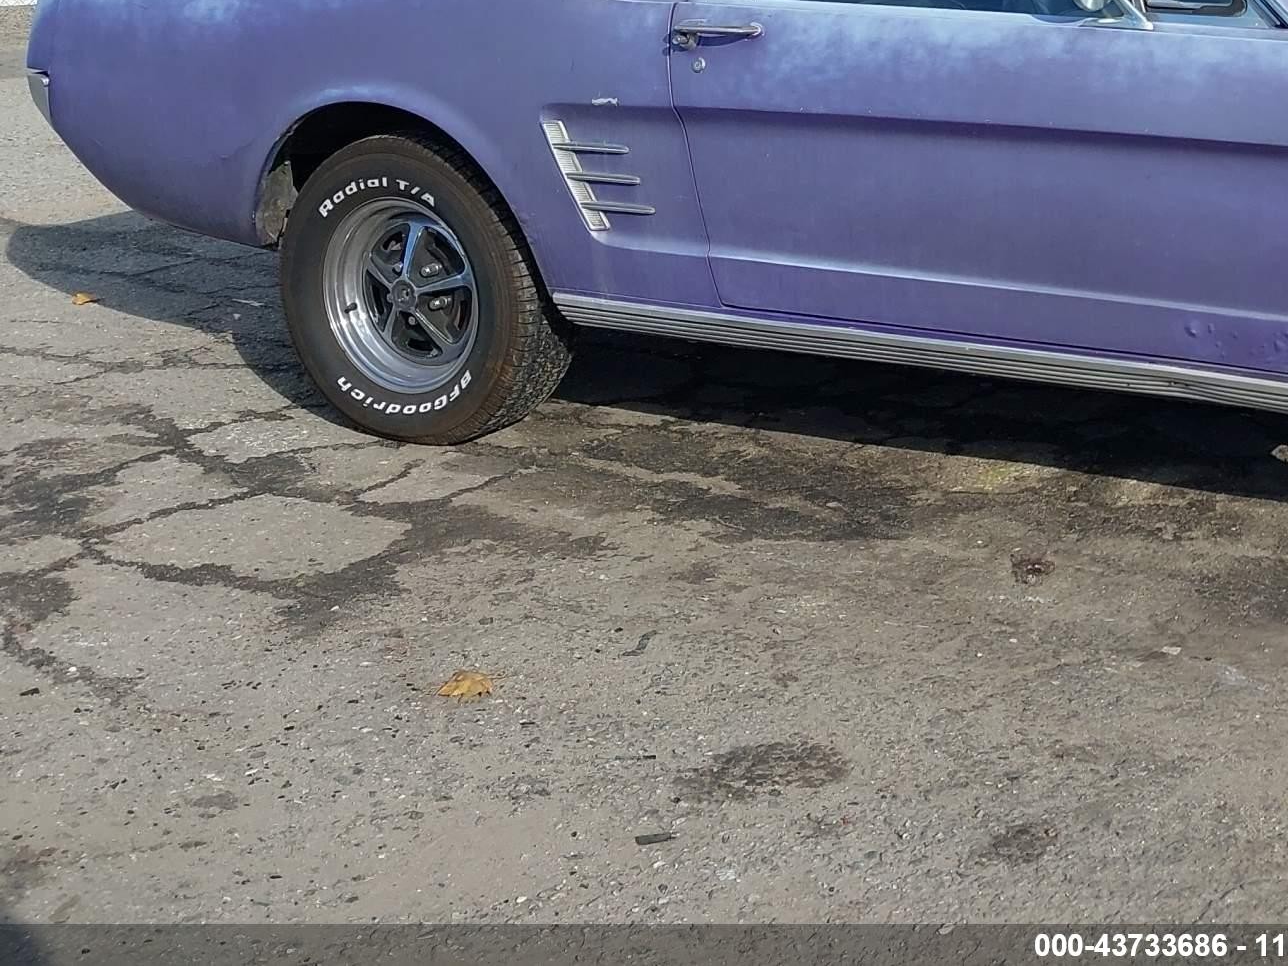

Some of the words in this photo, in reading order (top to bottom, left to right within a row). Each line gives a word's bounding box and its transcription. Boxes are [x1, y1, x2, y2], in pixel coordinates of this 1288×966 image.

[317, 177, 388, 218] Radial
[395, 179, 436, 208] T/A
[337, 369, 473, 415] BFGoodrich
